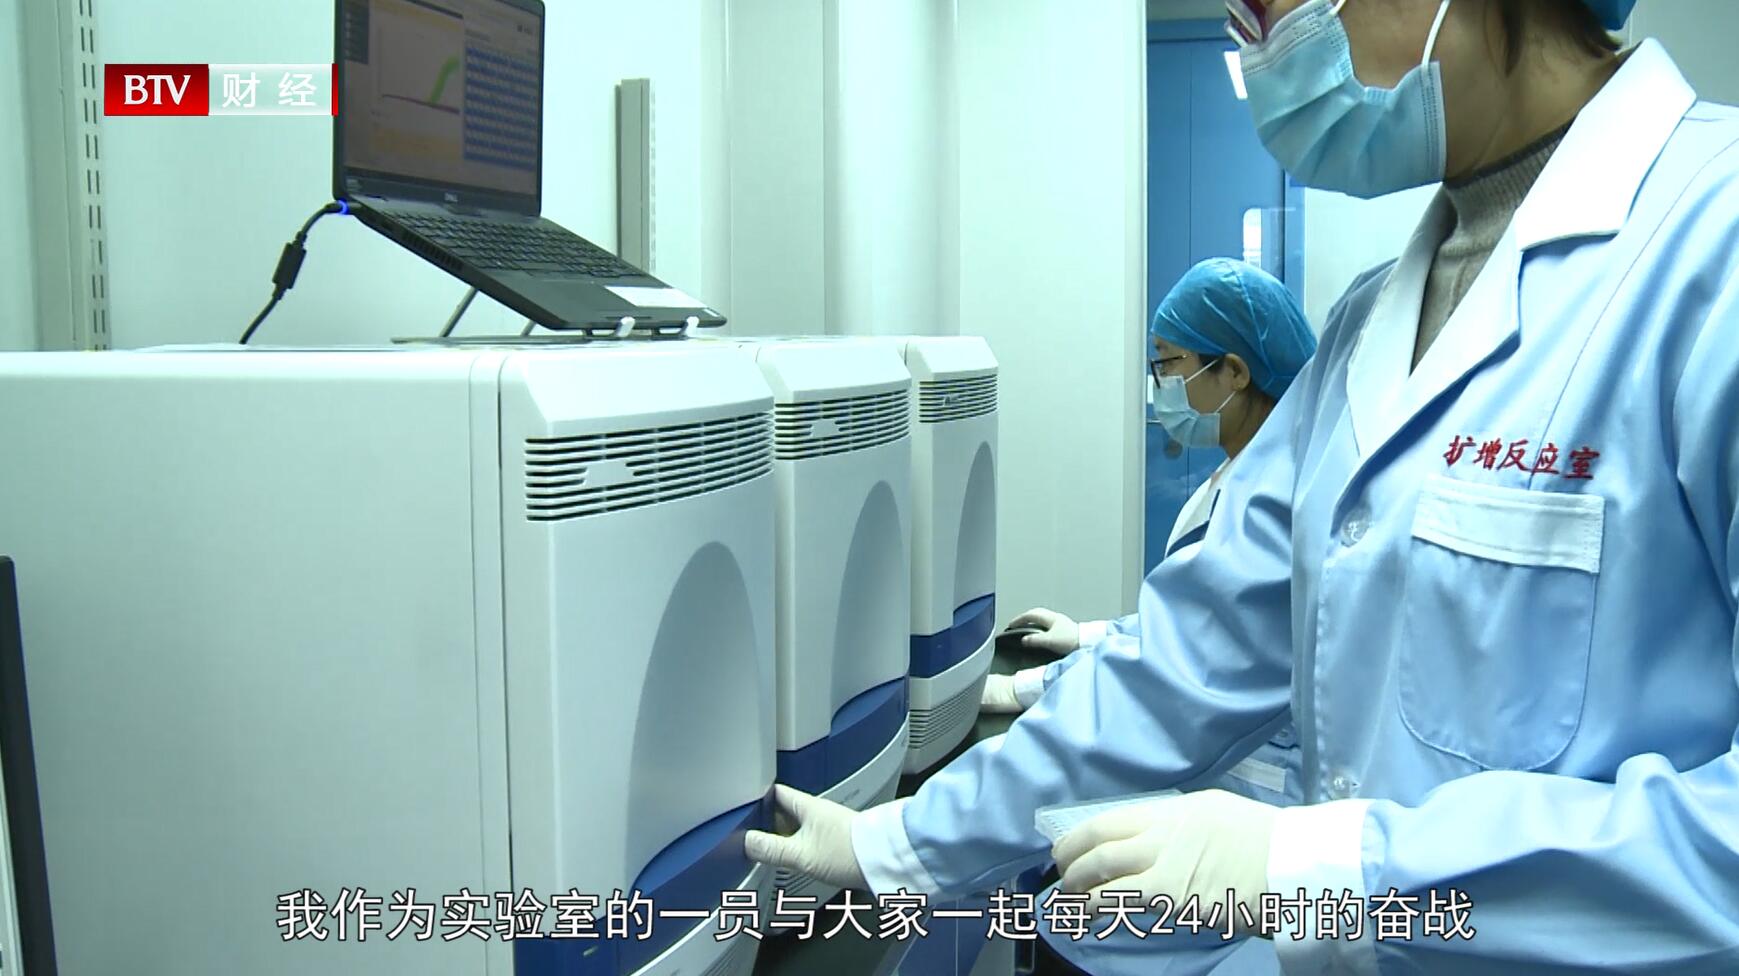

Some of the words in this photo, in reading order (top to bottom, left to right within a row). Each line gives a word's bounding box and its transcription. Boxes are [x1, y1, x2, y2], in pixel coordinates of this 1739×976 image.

[1443, 434, 1600, 480] 扩增反应室
